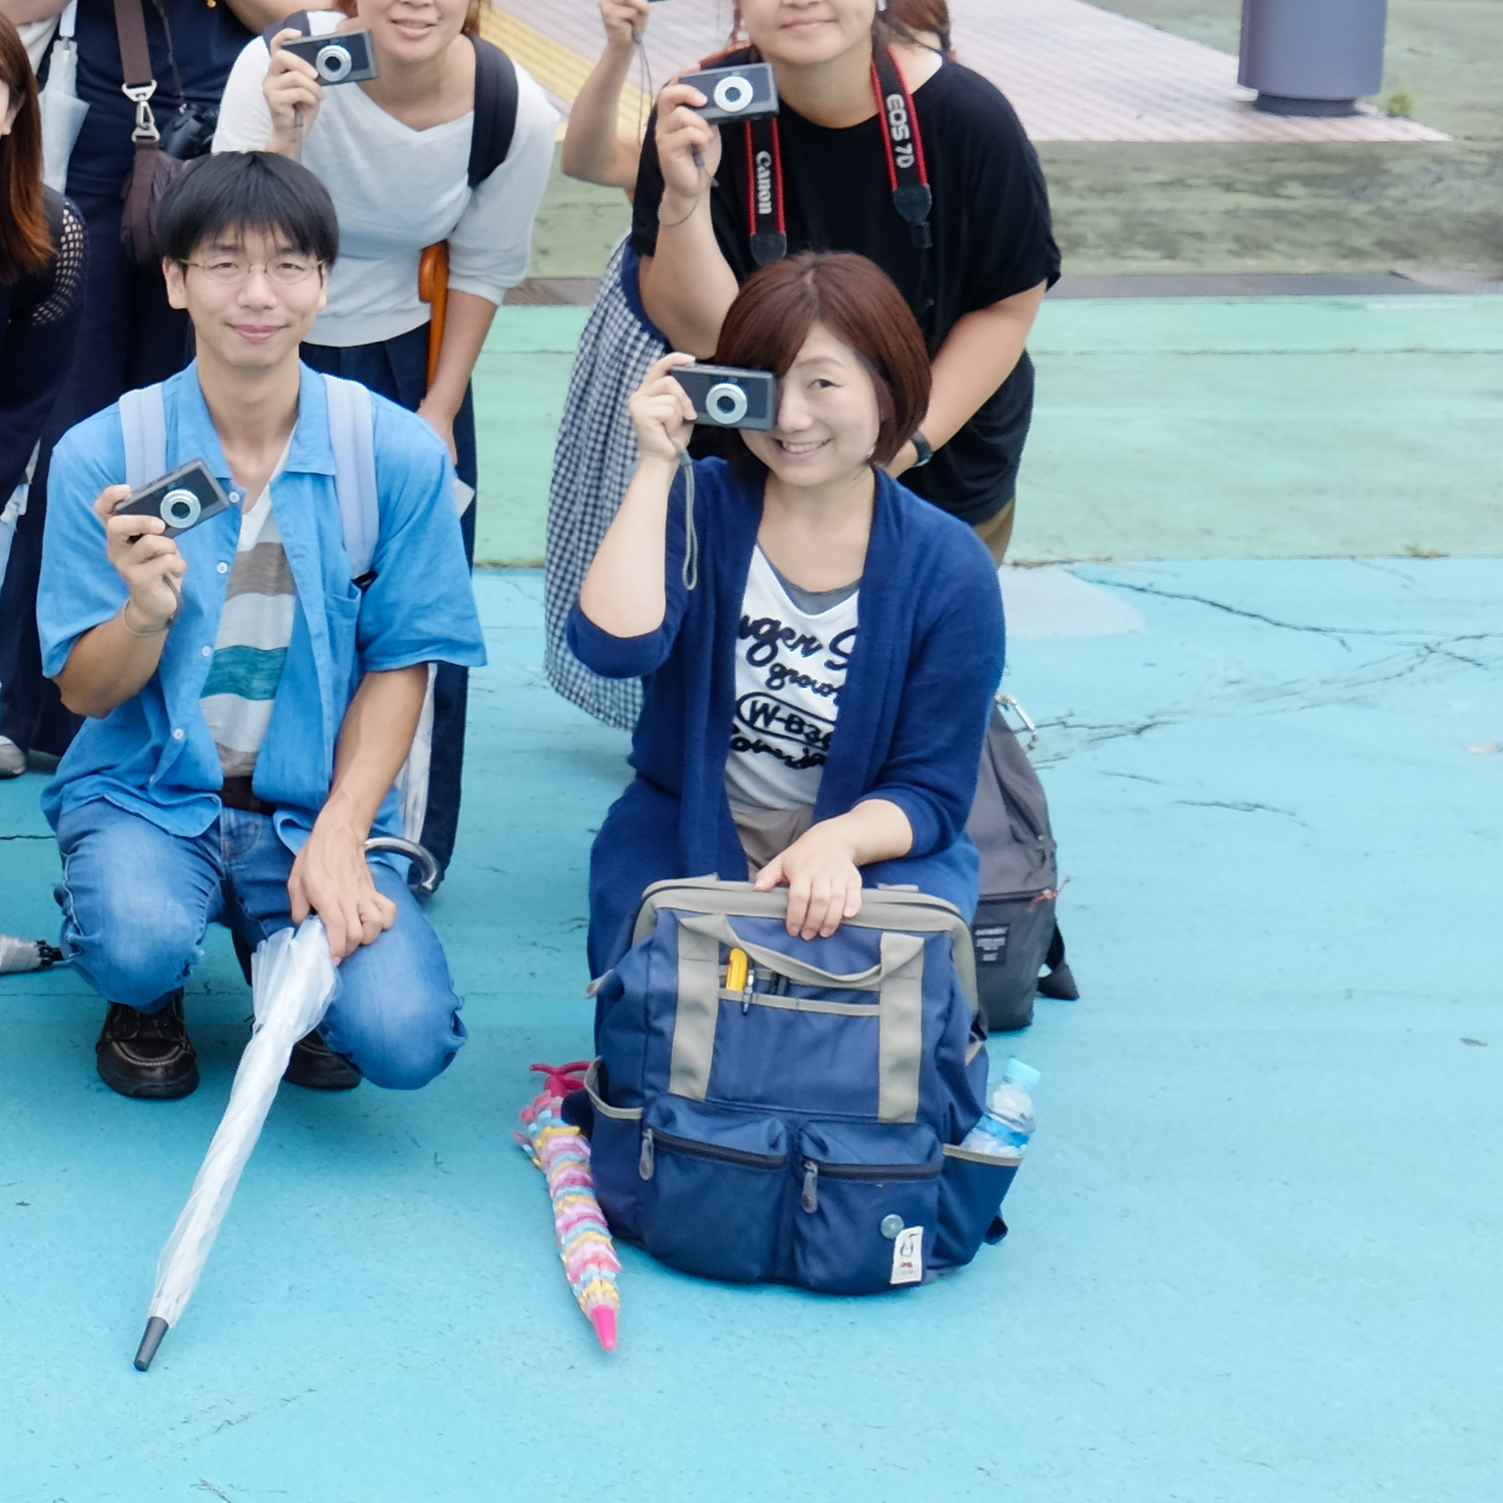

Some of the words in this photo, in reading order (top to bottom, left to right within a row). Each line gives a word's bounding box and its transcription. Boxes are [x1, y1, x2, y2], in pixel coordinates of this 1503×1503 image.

[886, 94, 911, 141] EOS
[895, 143, 915, 169] 7D
[756, 150, 773, 215] Canon
